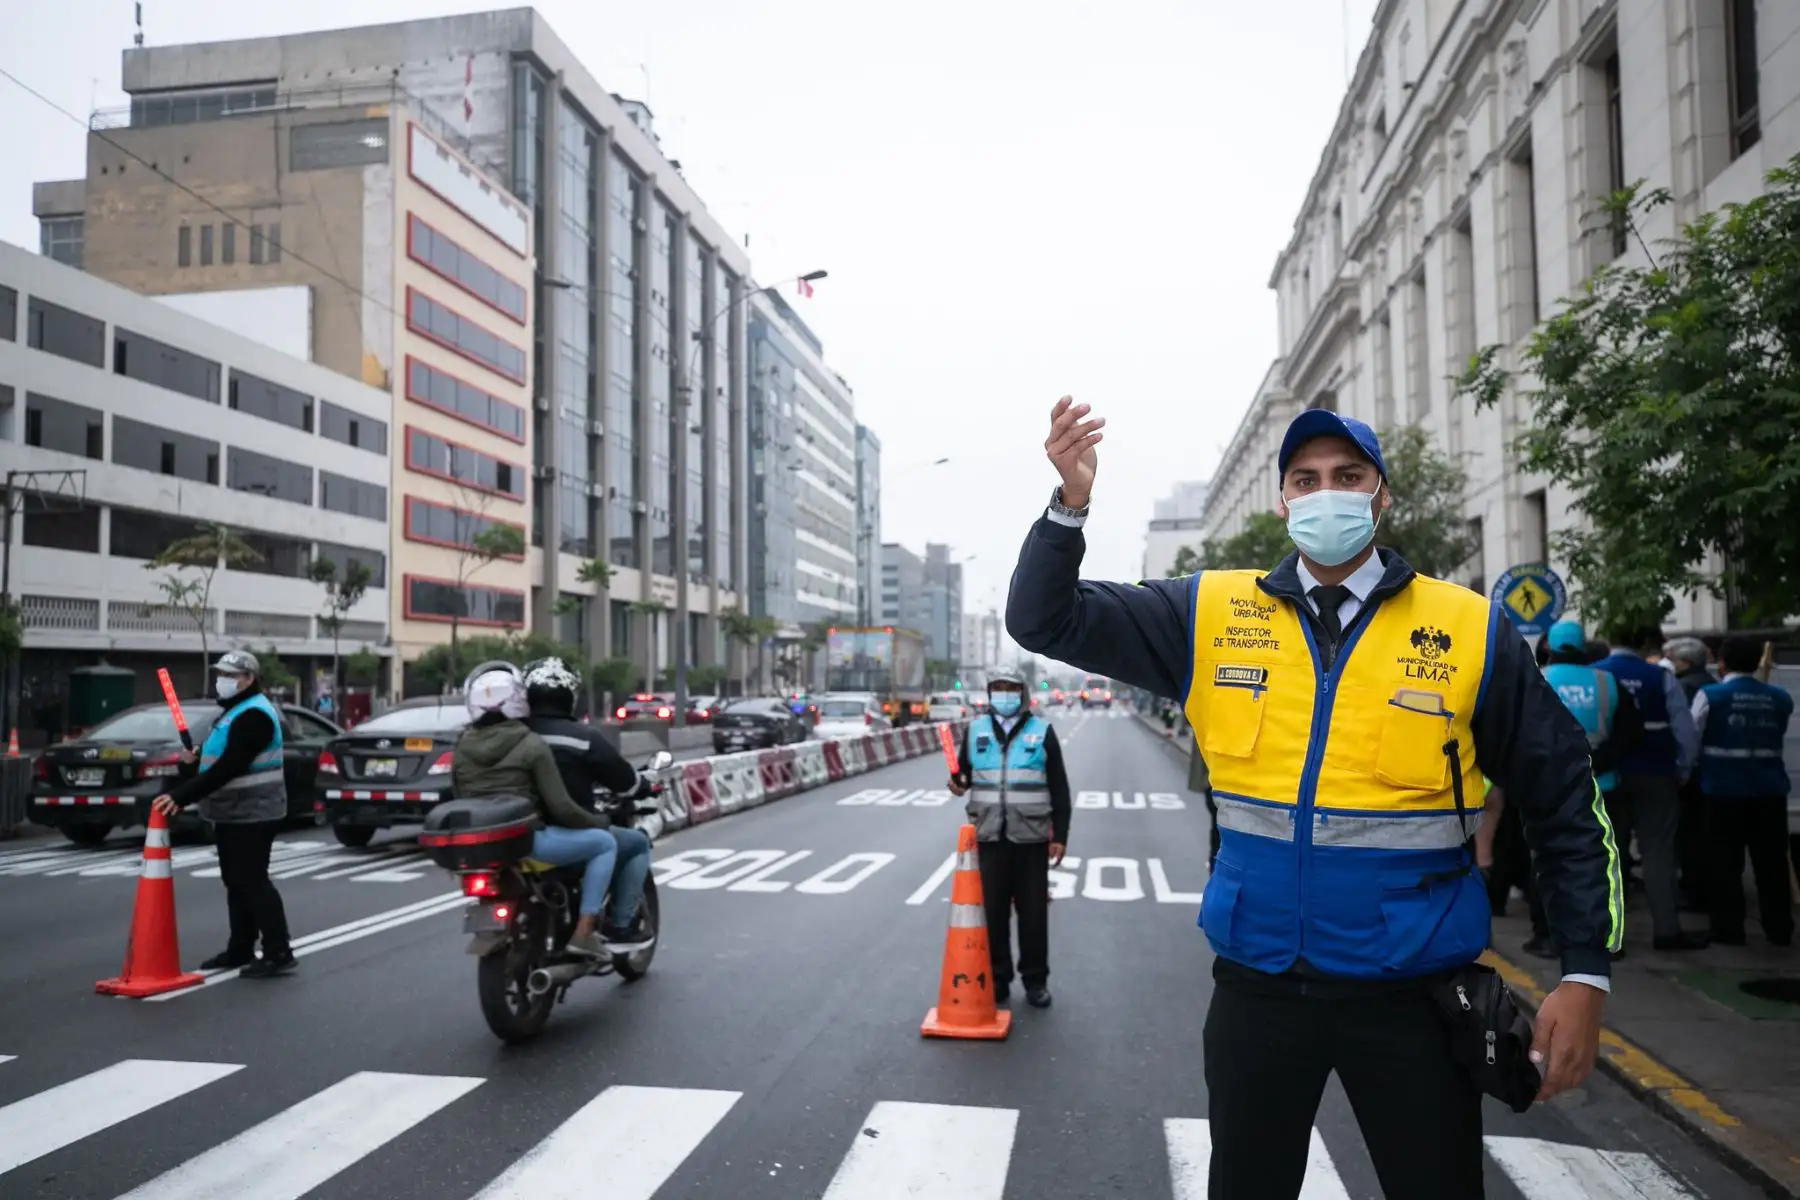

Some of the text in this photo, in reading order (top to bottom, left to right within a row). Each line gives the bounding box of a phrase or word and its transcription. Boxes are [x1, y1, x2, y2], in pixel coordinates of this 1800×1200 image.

[1233, 608, 1270, 621] URBANA
[1225, 626, 1272, 638] INSPECTOR
[1213, 637, 1280, 650] DE TRANSPORTE
[1397, 657, 1458, 673] MUNICIPALIDAD DE
[1405, 664, 1450, 685] LIMA
[836, 789, 953, 806] BUS
[1075, 790, 1186, 810] BUS
[651, 848, 897, 895] SOLO
[1047, 855, 1210, 904] SOL
